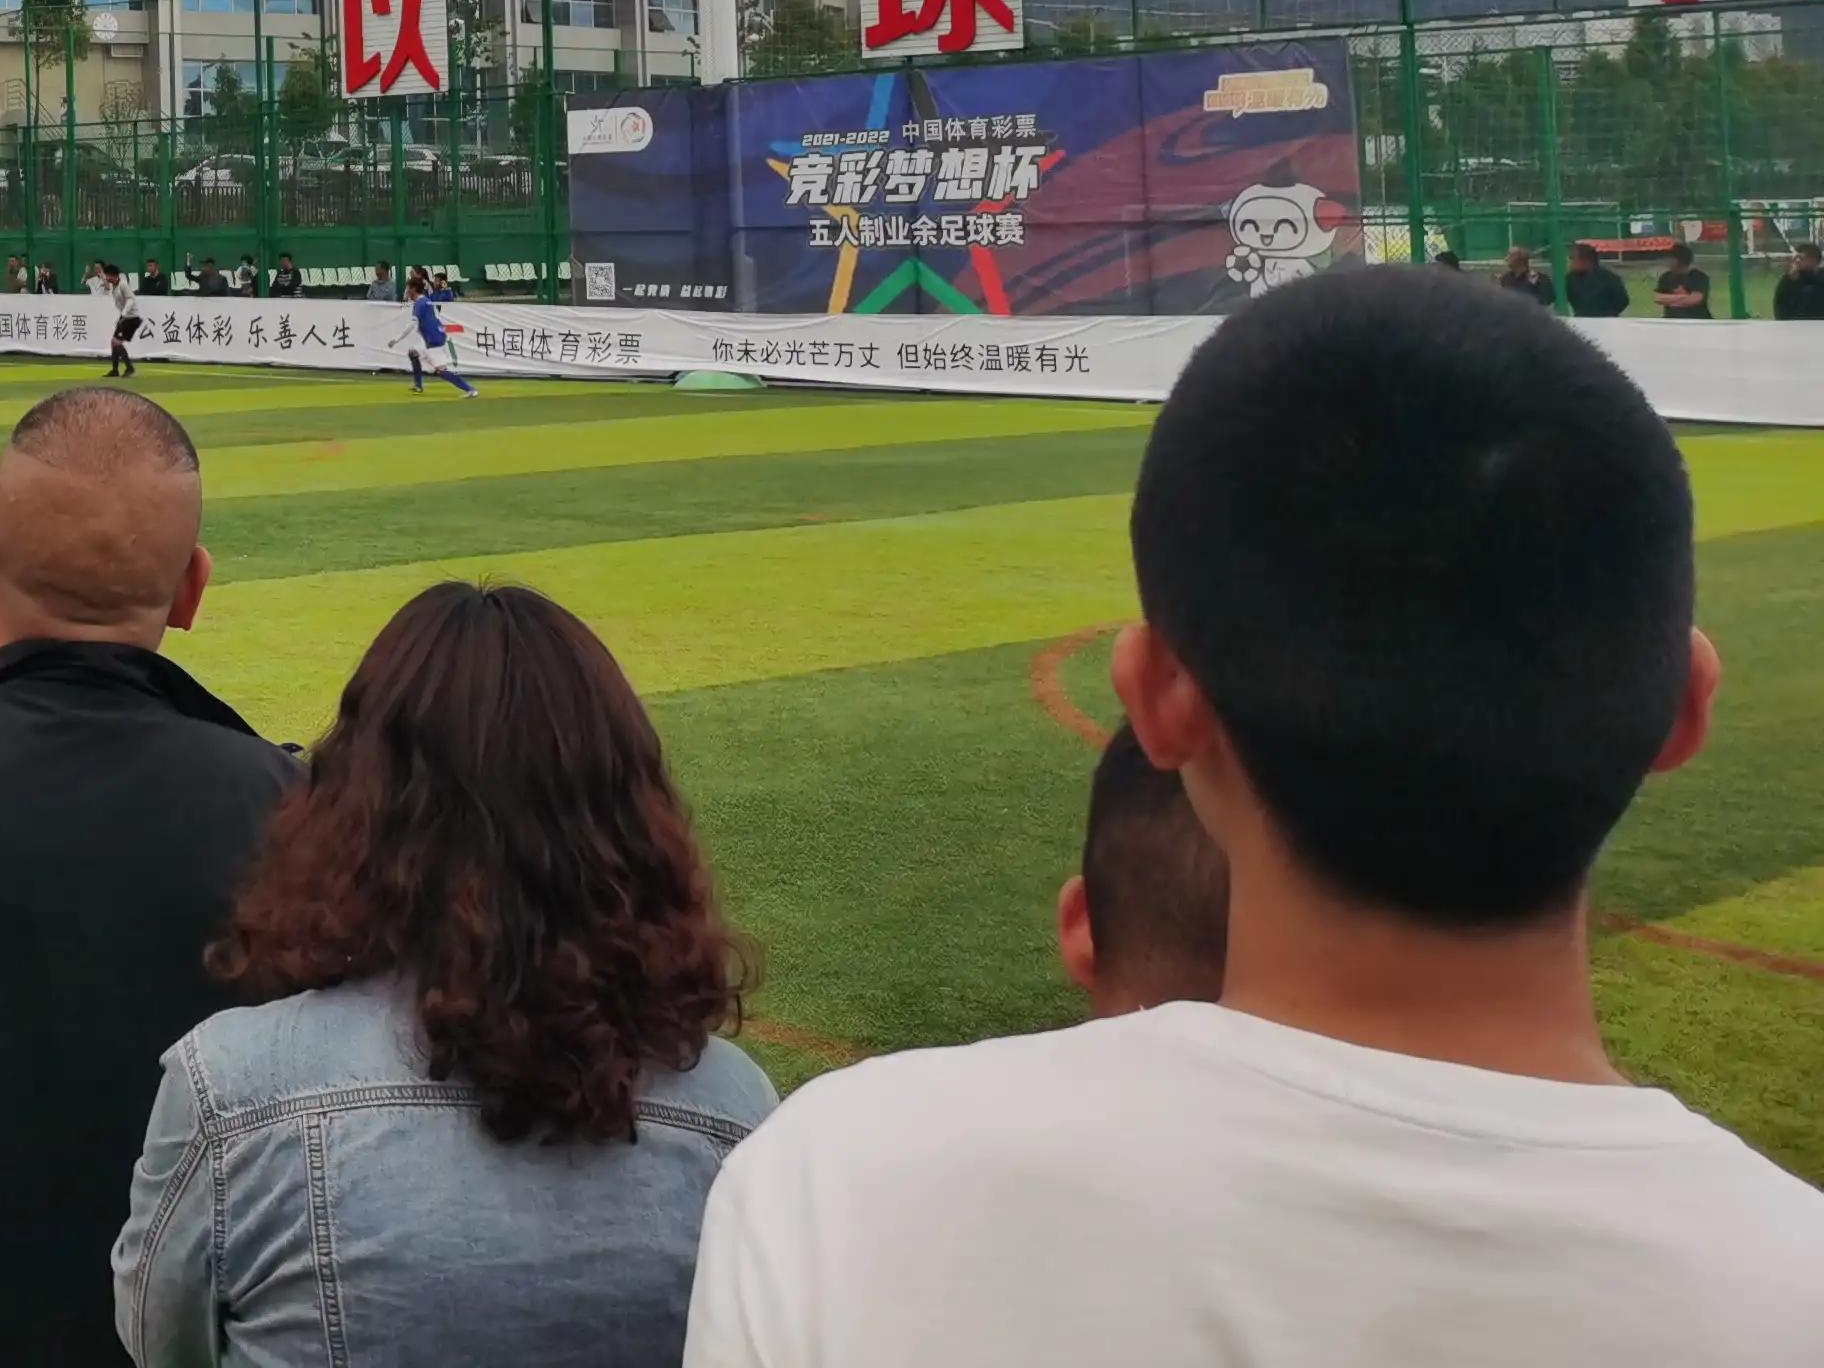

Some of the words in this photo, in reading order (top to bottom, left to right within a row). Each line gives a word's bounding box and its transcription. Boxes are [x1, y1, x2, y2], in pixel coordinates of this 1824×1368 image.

[802, 130, 891, 147] 2021-2022
[901, 113, 1037, 144] 中国体育彩票
[785, 145, 1047, 205] 竞彩梦想杯
[809, 213, 1025, 248] 五人制业余足球赛
[137, 312, 234, 347] 公益体彩
[247, 313, 356, 351] 乐善人生
[476, 326, 643, 365] 中国体育彩票
[712, 337, 881, 370] 你未必光芒万丈
[896, 342, 1091, 374] 但始终温暖有光
